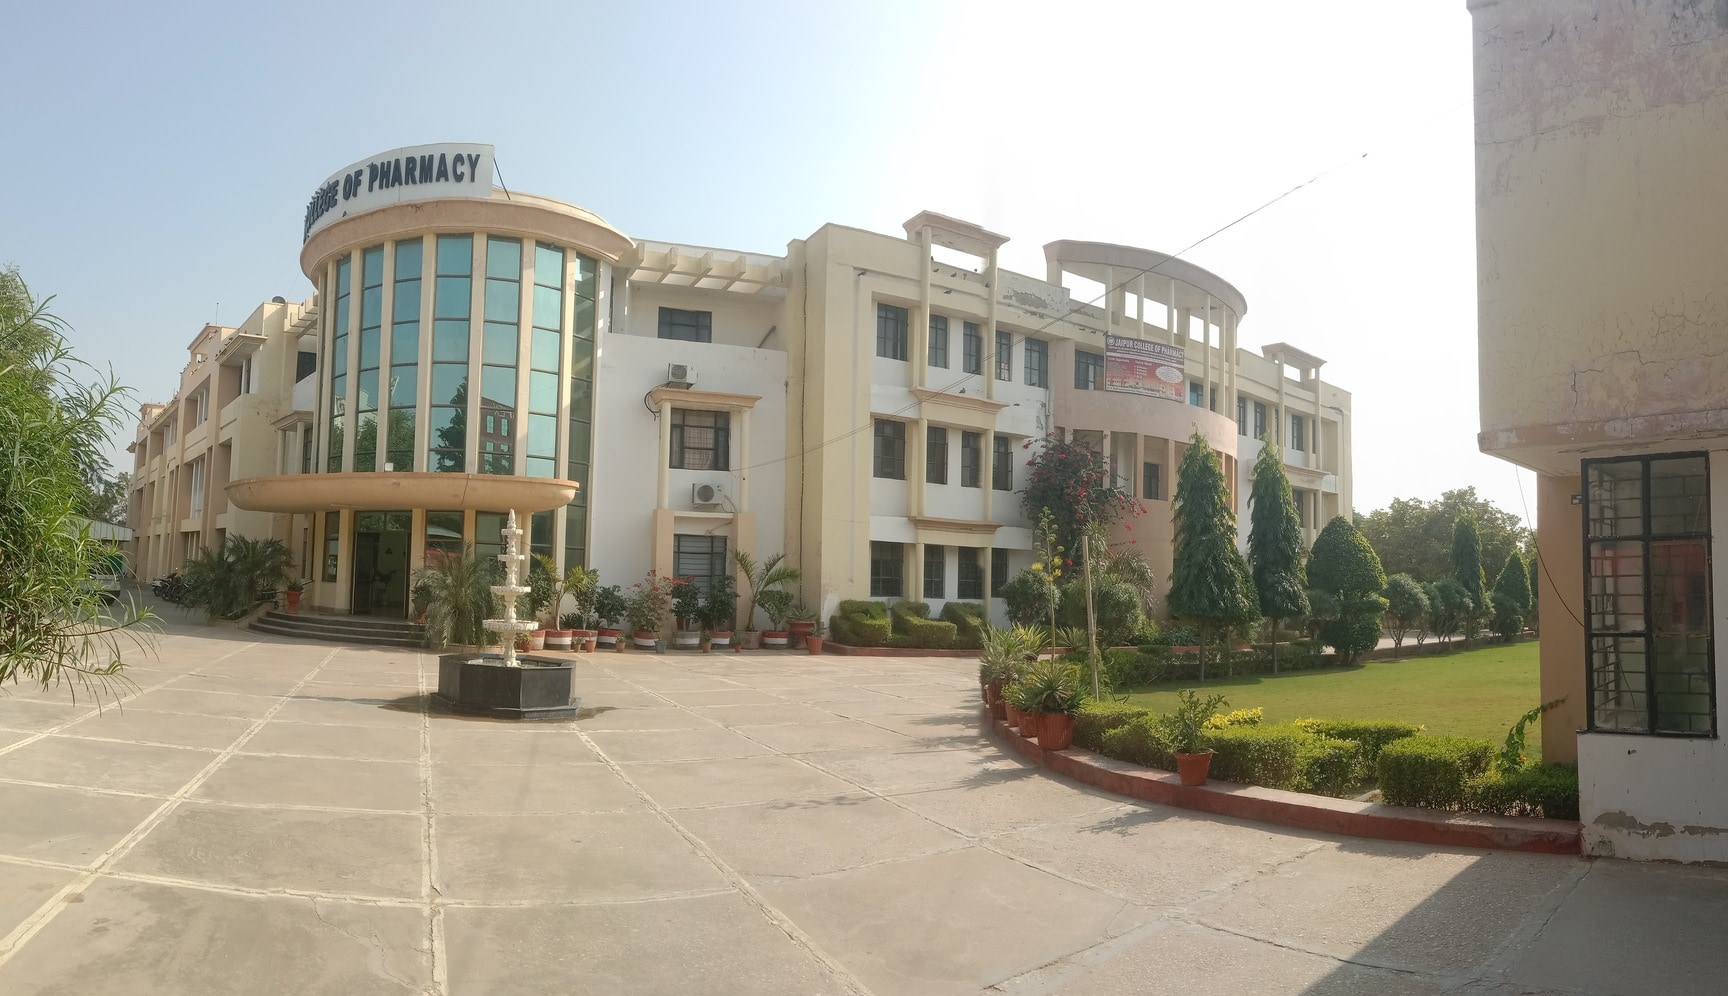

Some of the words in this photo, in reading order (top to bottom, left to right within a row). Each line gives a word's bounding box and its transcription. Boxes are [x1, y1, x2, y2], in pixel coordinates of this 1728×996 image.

[343, 168, 363, 201] OF
[367, 152, 481, 193] PHARMACY
[1115, 338, 1134, 348] JAIPUR
[1134, 341, 1154, 351] COLLEGE
